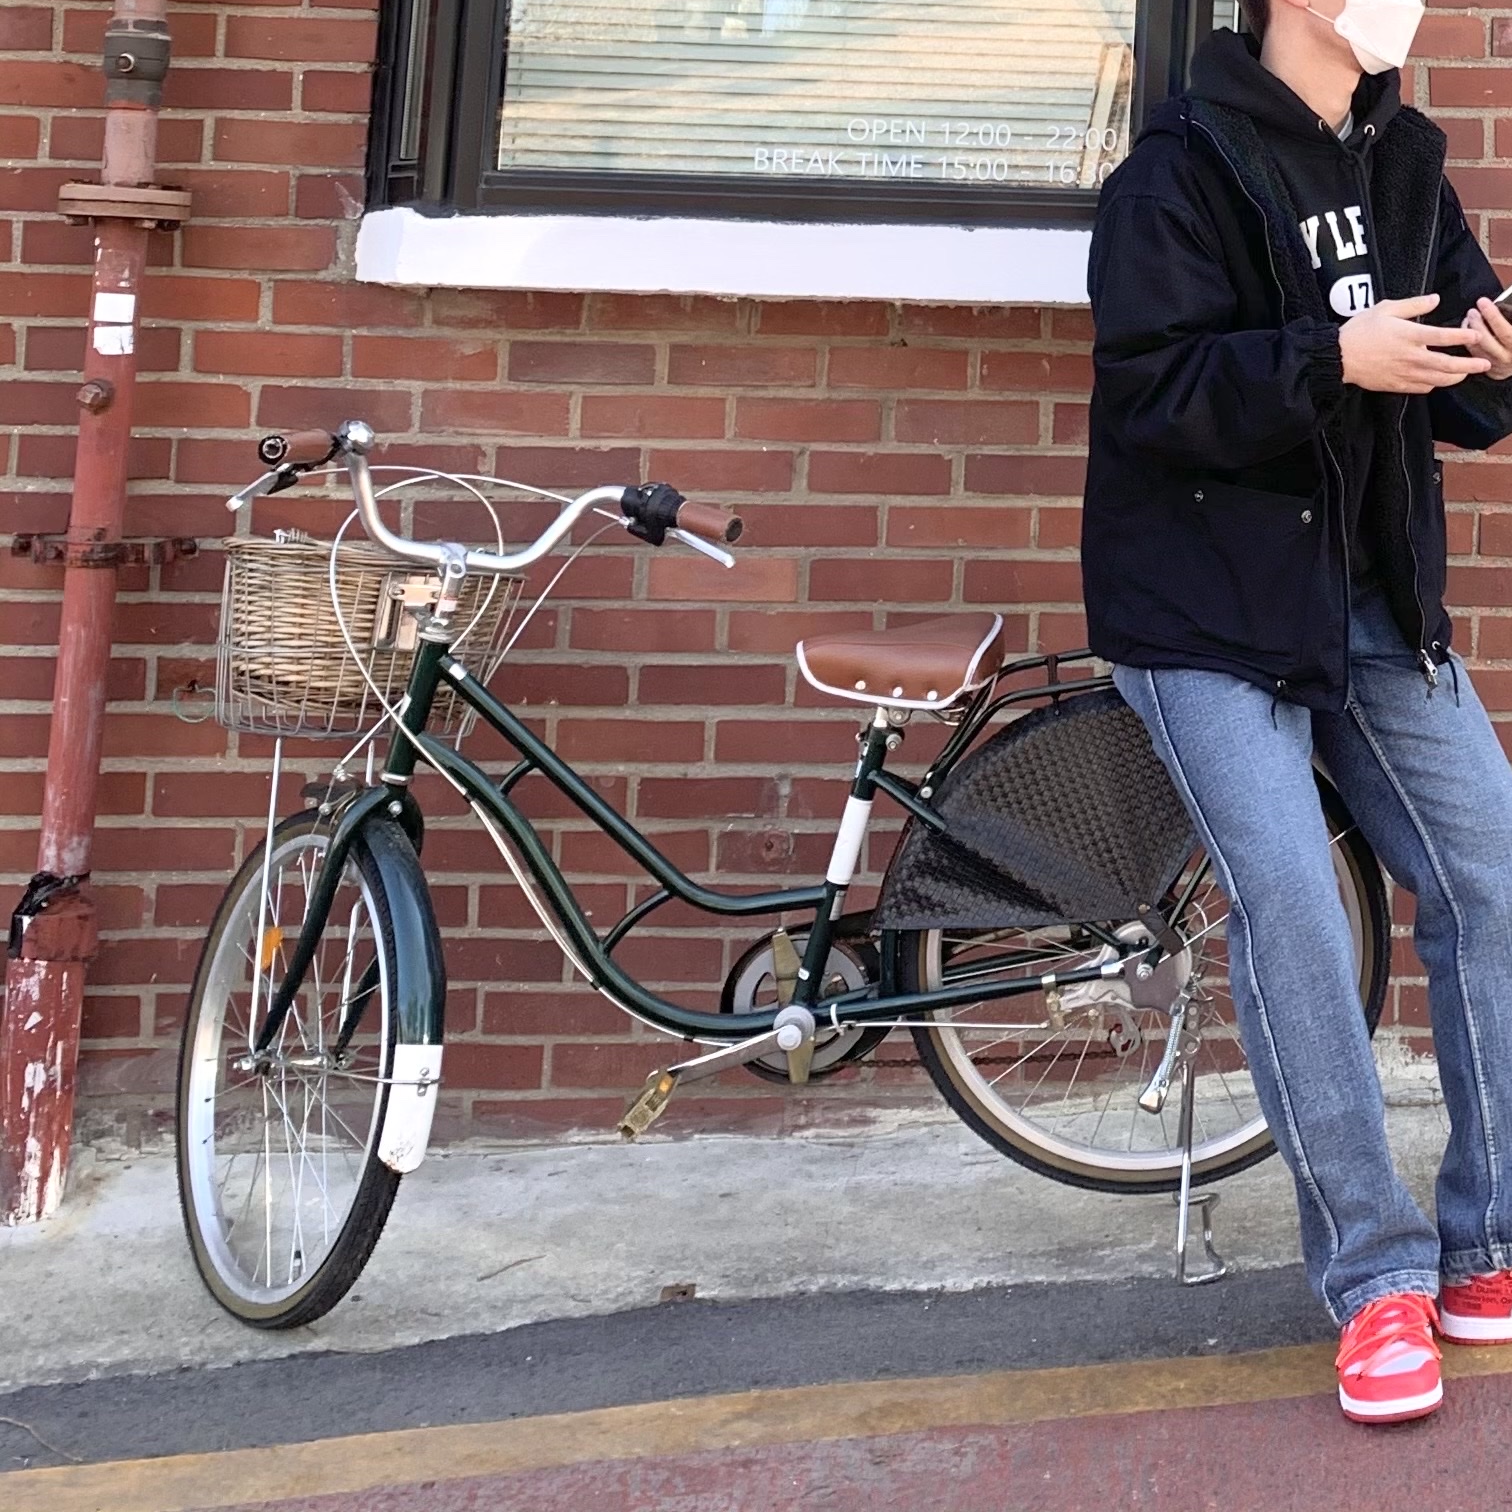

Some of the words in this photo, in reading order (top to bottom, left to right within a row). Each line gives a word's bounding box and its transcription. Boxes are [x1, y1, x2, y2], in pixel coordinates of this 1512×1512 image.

[847, 118, 927, 144] OPEN
[940, 121, 1011, 147] 12:00
[1045, 126, 1117, 152] 22:00
[753, 147, 845, 176] BREAK
[858, 152, 923, 179] TIME
[937, 155, 1008, 182] 15:00
[1347, 281, 1370, 311] 17
